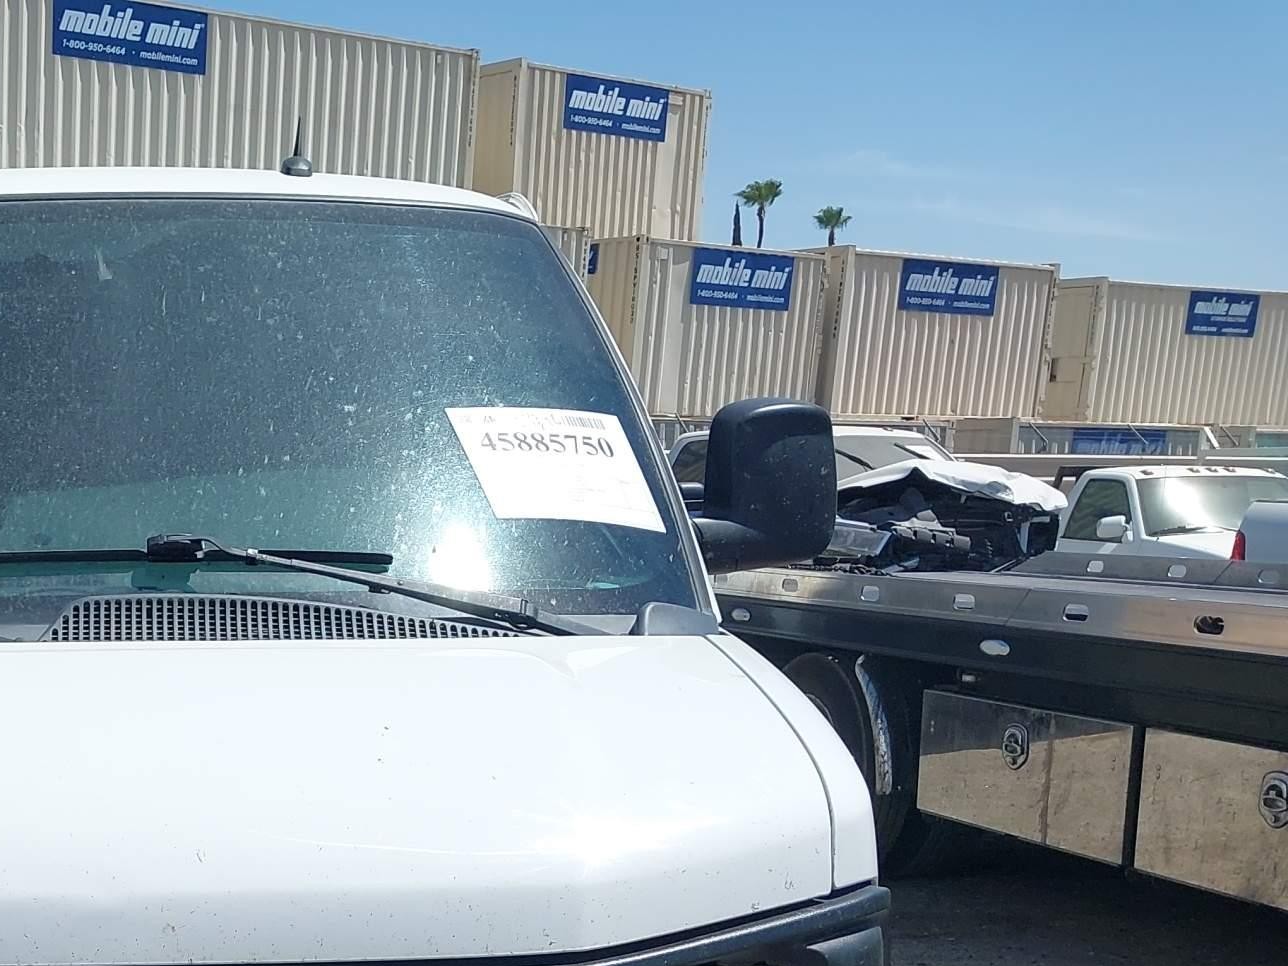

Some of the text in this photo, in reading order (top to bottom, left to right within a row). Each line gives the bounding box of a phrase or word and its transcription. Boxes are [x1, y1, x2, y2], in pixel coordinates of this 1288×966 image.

[59, 5, 201, 49] mobile mini
[62, 38, 126, 56] 1-800-950-6464
[568, 84, 664, 120] mobile mini
[696, 257, 790, 290] mobile mini
[905, 267, 995, 297] mobile mini
[481, 432, 614, 457] 45885750
